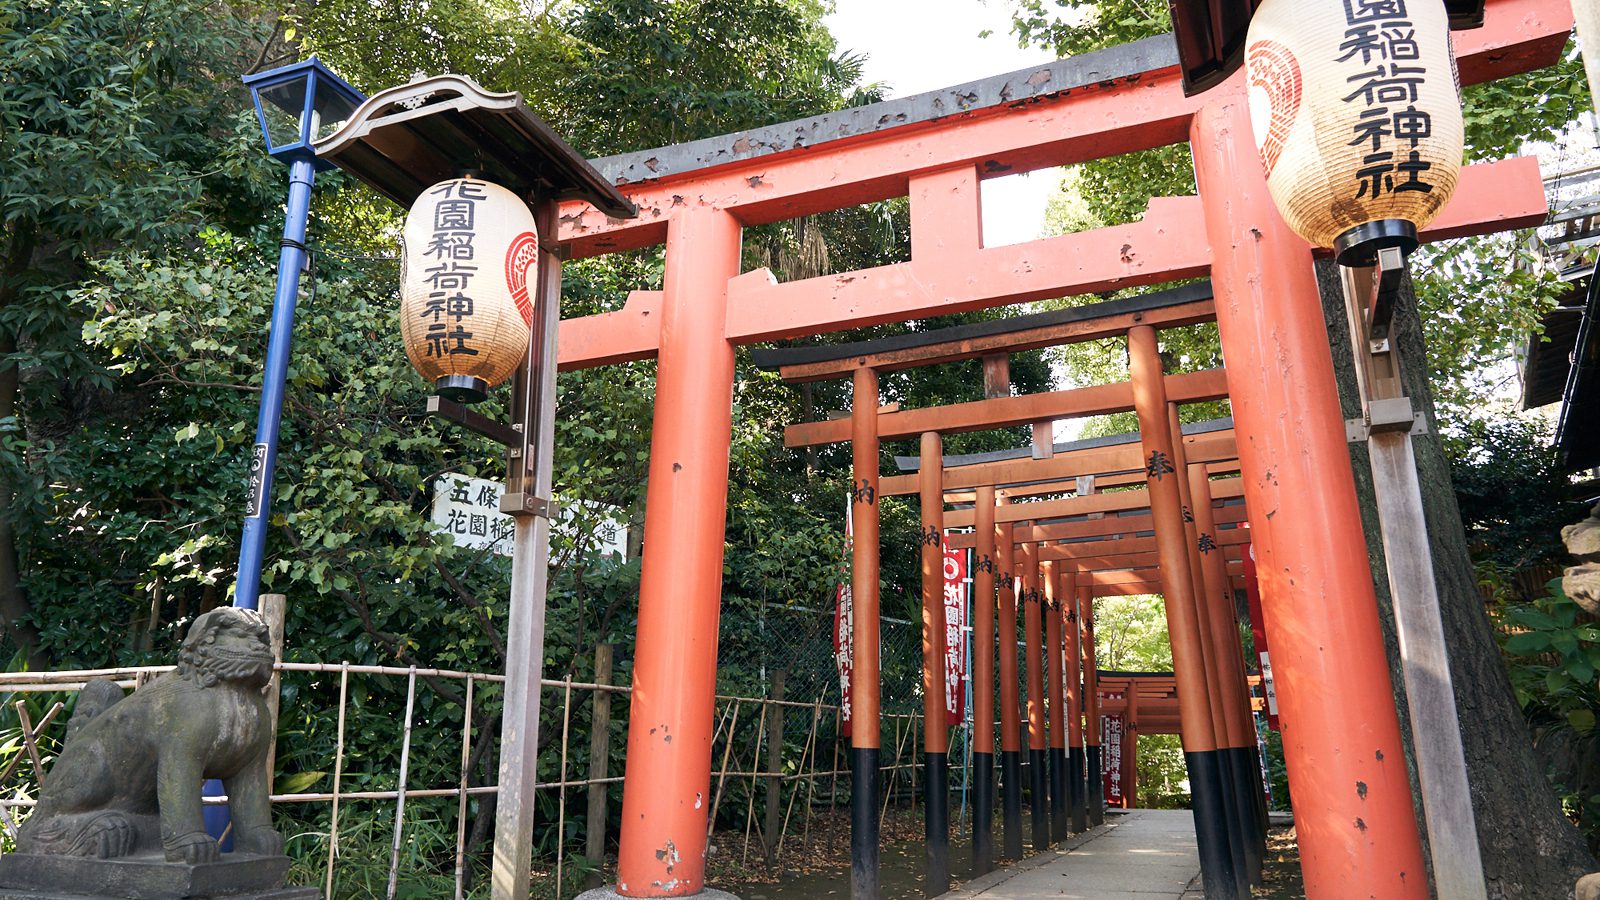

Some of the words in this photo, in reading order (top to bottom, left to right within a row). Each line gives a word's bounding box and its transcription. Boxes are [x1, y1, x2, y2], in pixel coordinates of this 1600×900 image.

[420, 180, 487, 358] 花園稲荷神社
[1146, 450, 1175, 481] 奉
[852, 478, 875, 506] 納
[445, 509, 515, 542] 花園稲
